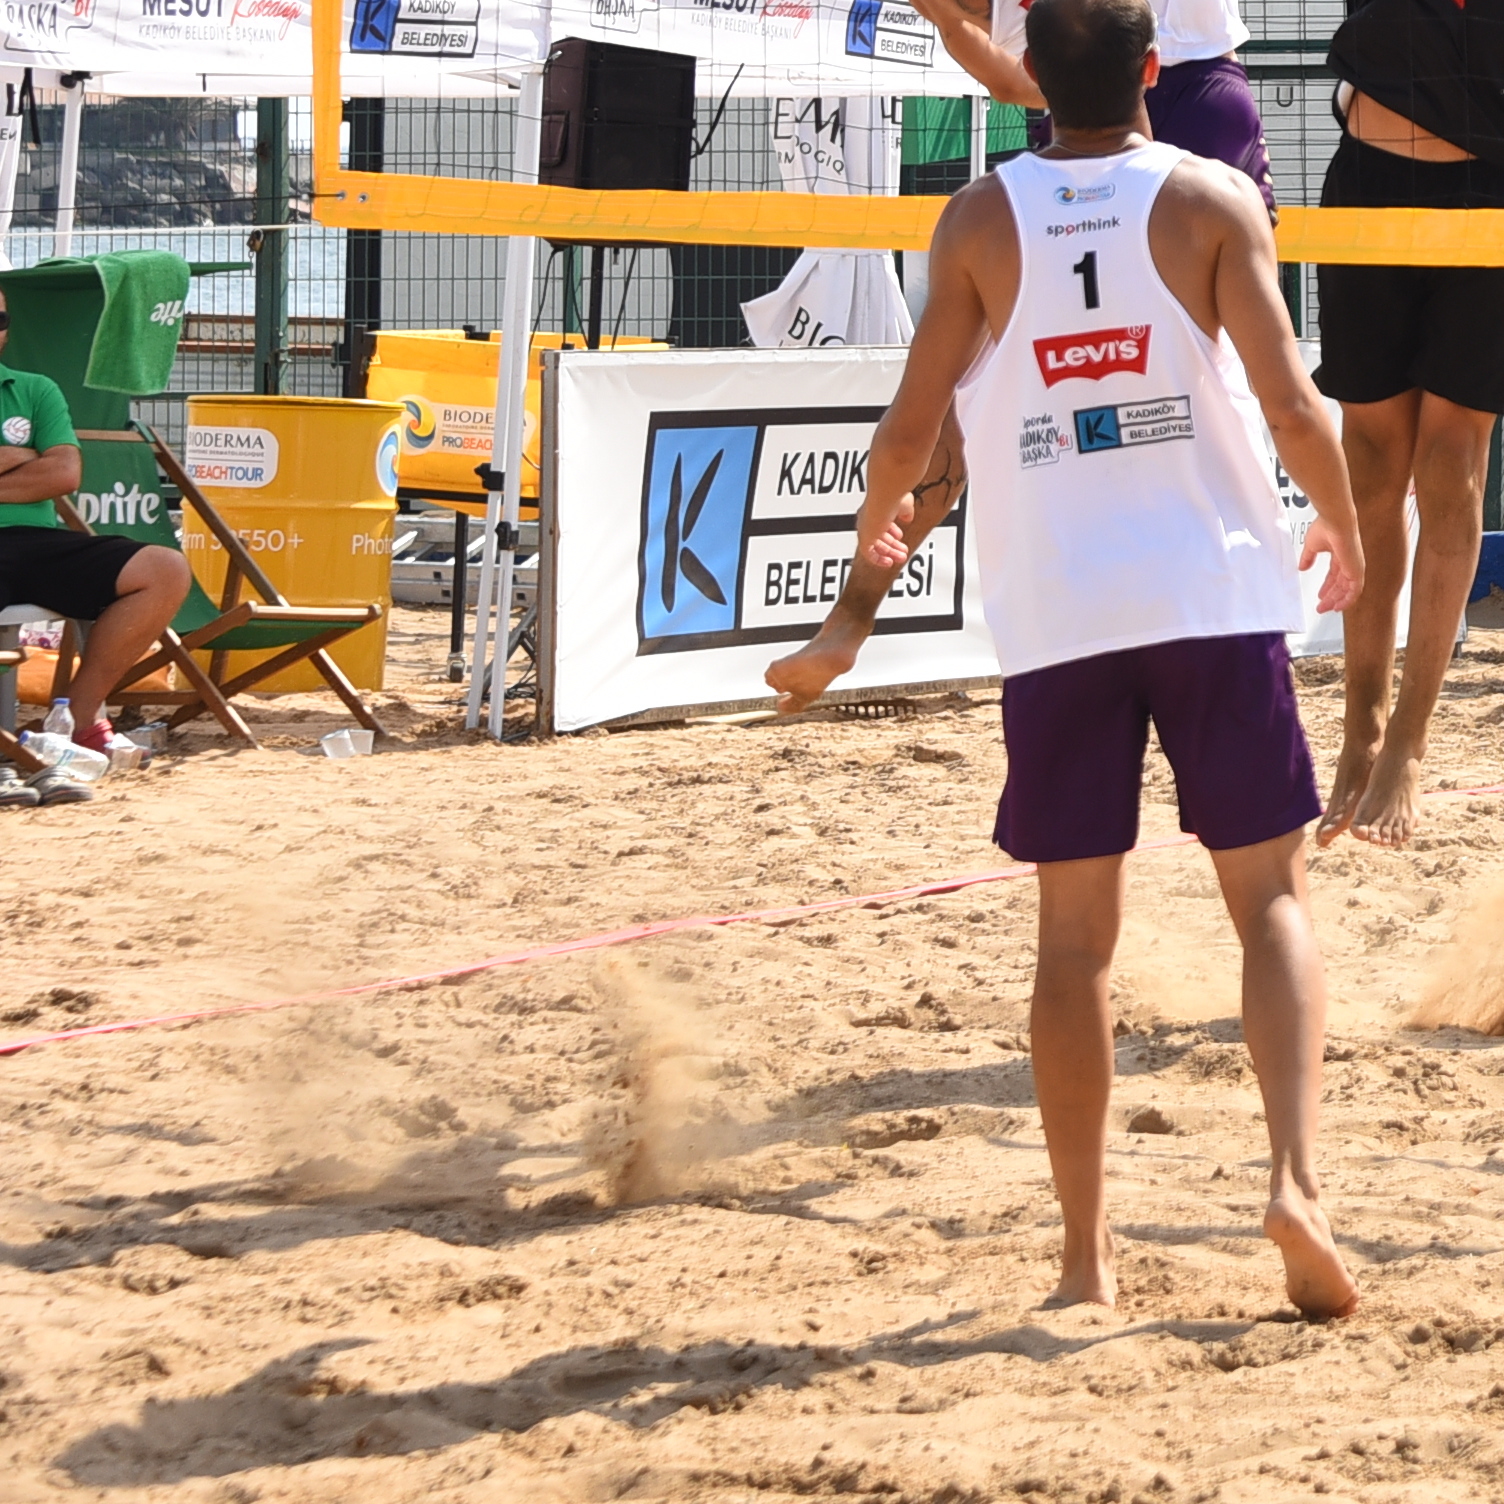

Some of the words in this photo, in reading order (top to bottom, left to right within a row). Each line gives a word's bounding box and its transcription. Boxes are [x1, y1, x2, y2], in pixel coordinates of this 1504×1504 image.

[185, 25, 232, 41] BELEDİYE
[400, 30, 468, 48] BELEDİYESİ
[1046, 216, 1121, 237] sporthink
[1073, 250, 1100, 310] 1
[443, 409, 494, 424] BIODE
[1126, 403, 1177, 420] KADIKÖY
[777, 450, 870, 496] KADIK
